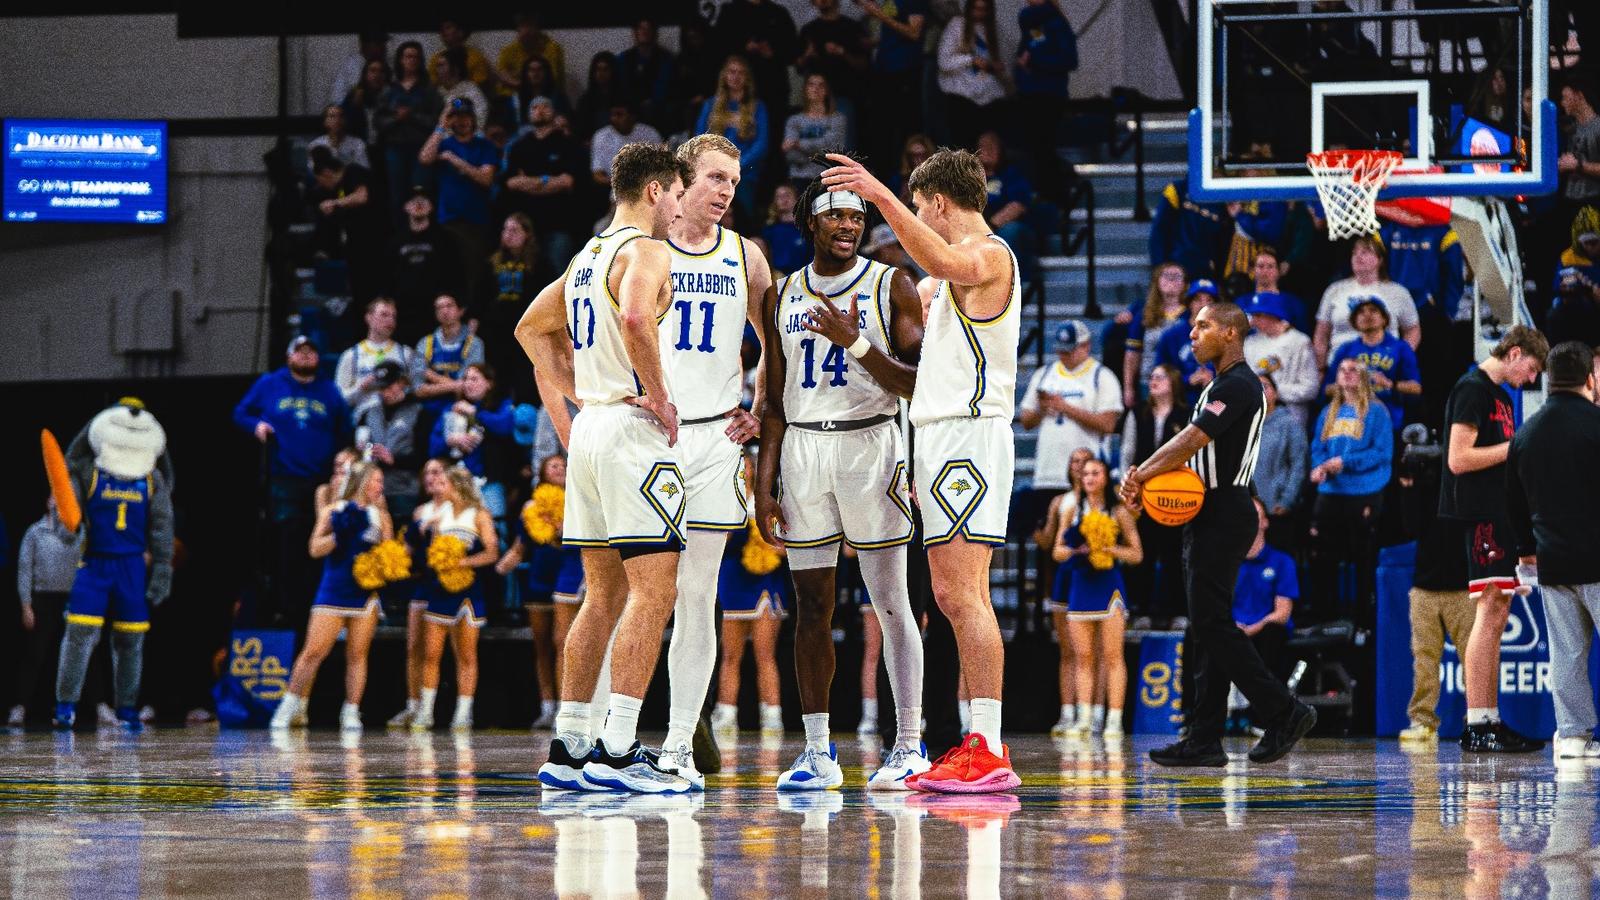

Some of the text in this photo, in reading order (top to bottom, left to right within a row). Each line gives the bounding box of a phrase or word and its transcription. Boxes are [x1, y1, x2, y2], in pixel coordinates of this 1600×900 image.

[675, 300, 716, 353] 11
[801, 339, 848, 388] 14
[116, 503, 127, 531] 1
[1157, 496, 1197, 508] Wilson
[260, 656, 288, 700] UP
[1141, 661, 1171, 708] GO
